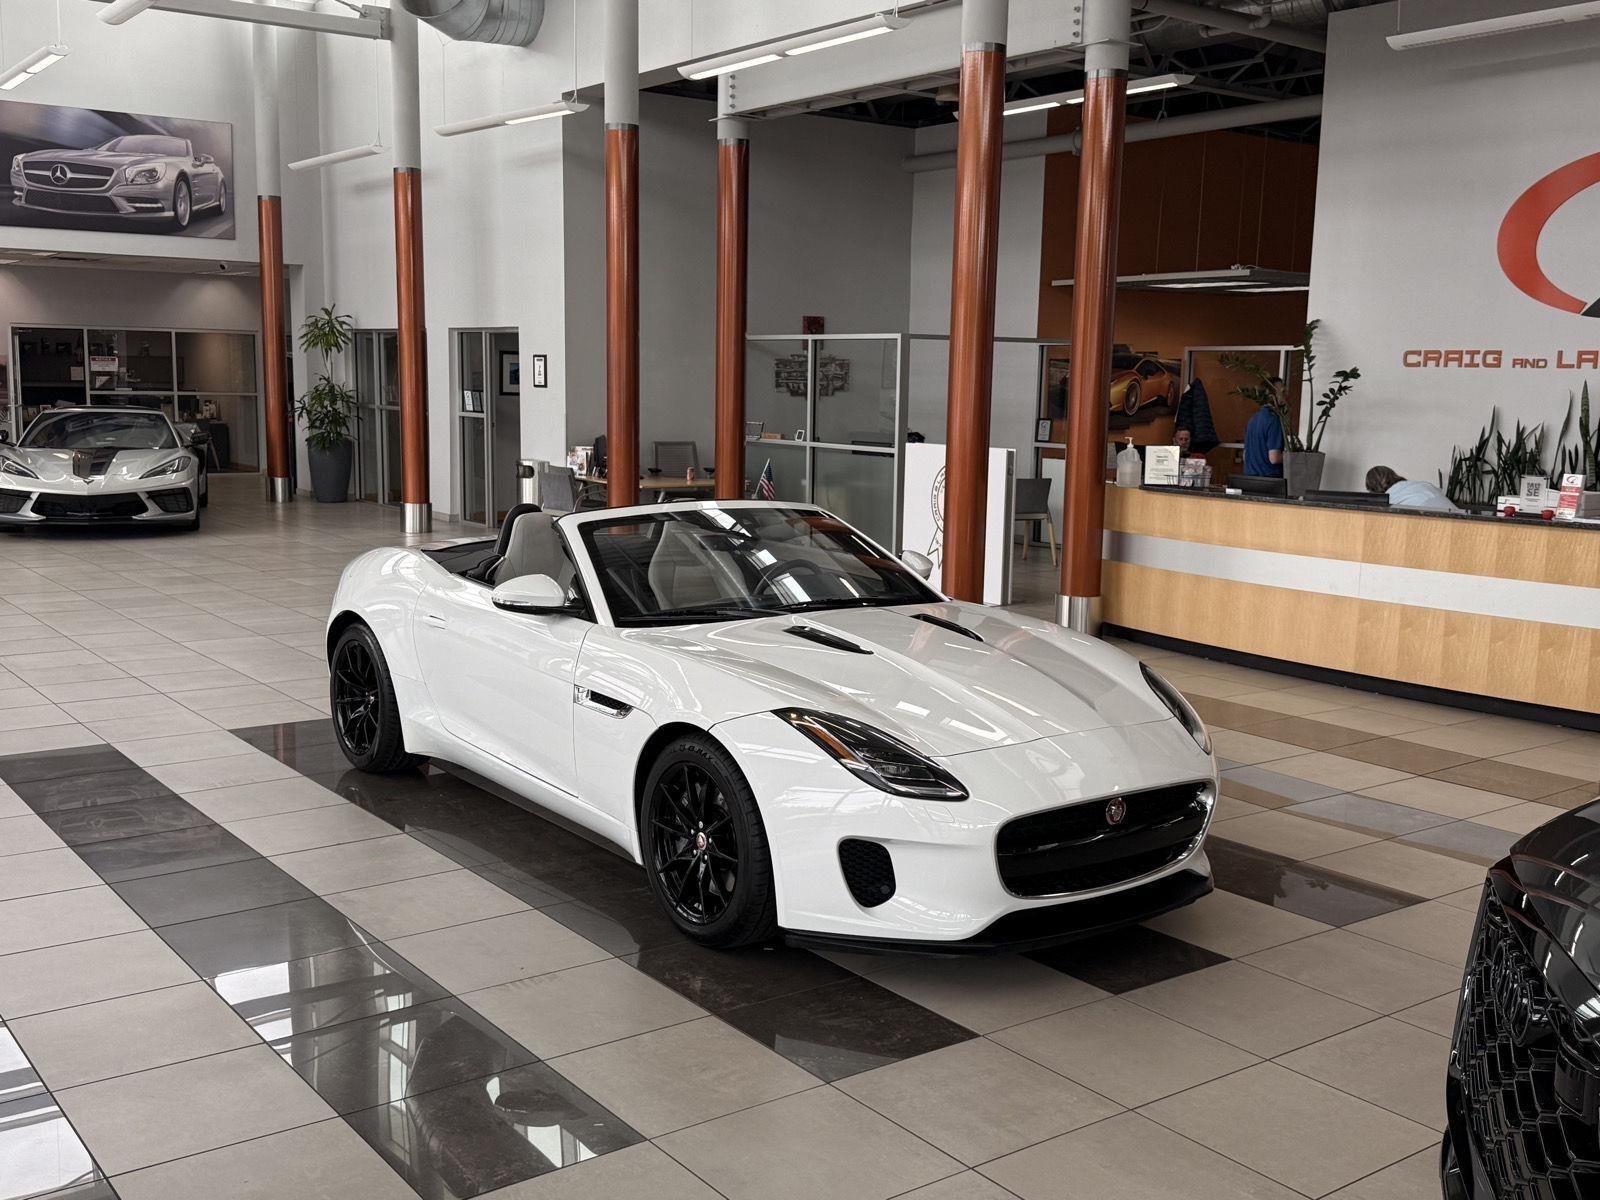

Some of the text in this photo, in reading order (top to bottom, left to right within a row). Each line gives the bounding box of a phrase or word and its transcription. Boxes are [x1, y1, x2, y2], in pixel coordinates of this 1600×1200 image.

[1402, 350, 1598, 369] CRAIG AND LA
[1526, 489, 1540, 497] SE
